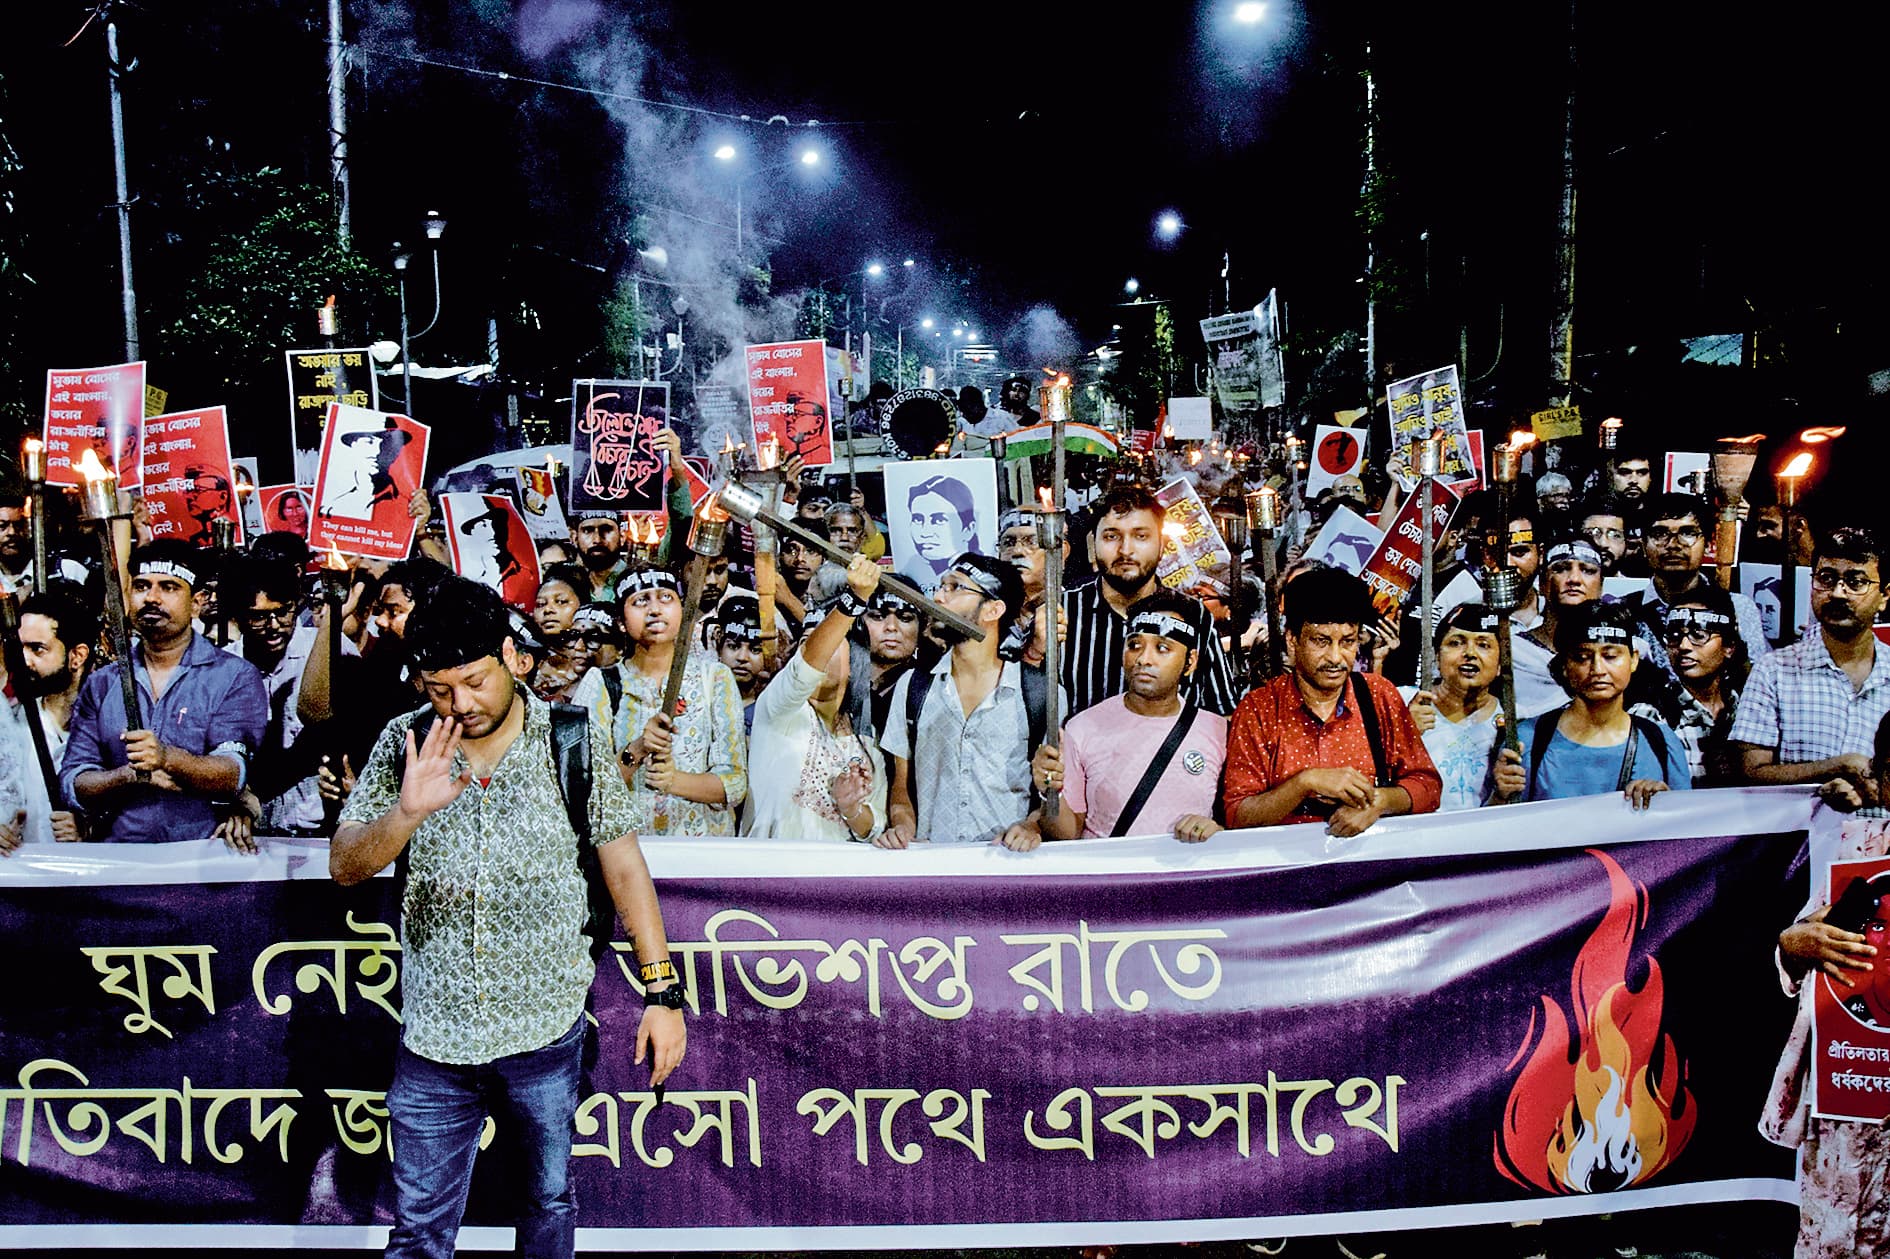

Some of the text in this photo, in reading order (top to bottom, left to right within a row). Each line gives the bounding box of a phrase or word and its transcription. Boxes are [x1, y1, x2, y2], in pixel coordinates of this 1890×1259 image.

[343, 353, 362, 367] ভয়
[315, 372, 337, 388] নাই
[153, 520, 174, 535] নেই
[80, 908, 1227, 1039] ঘুম নেই অভিশপ্ত রাতে
[0, 1058, 304, 1167] তিবাদে
[571, 1076, 763, 1169] এসো
[797, 1088, 992, 1167] পথে
[1024, 1069, 1407, 1162] একসাথে
